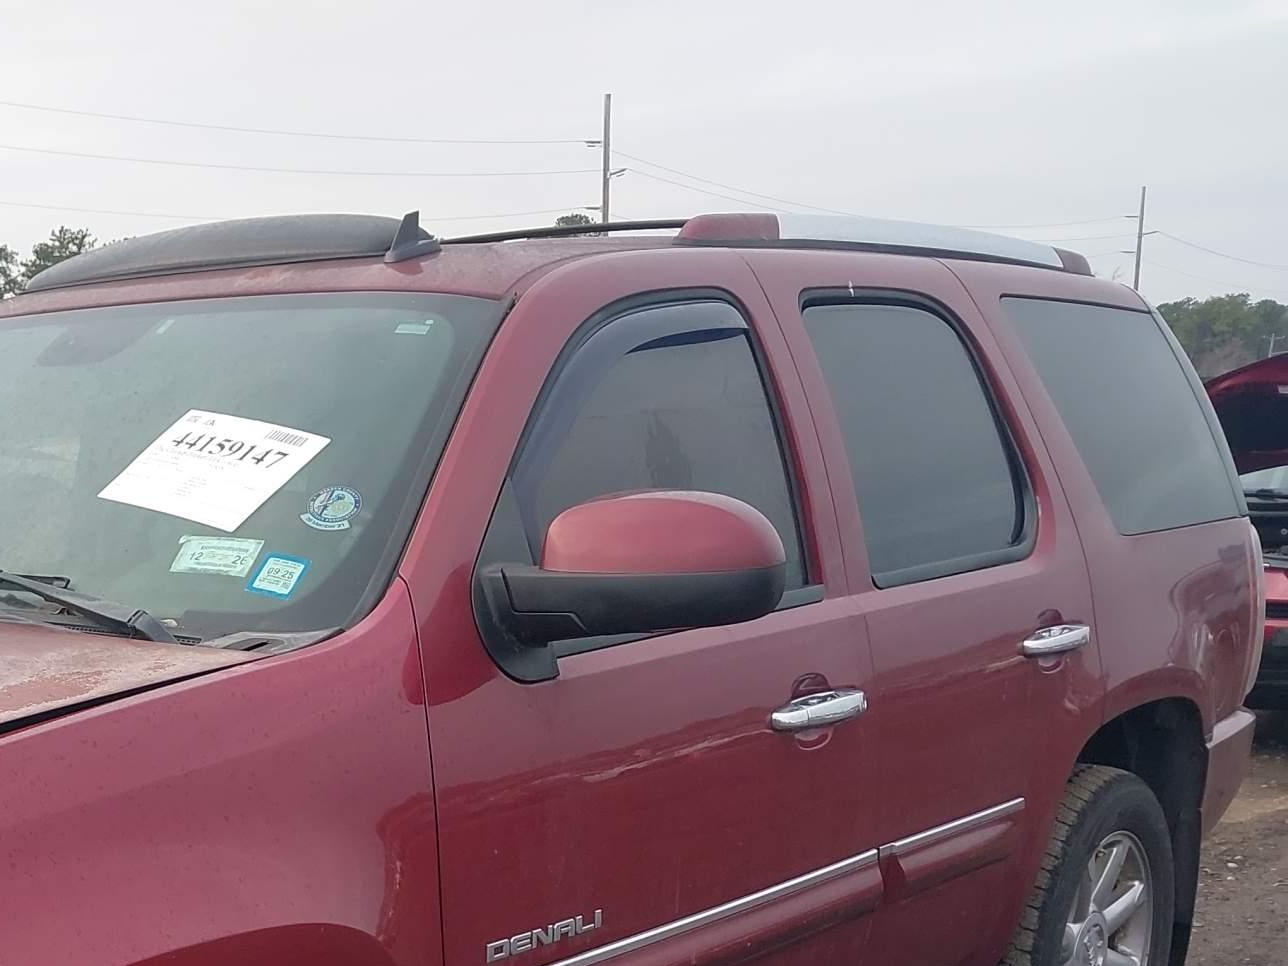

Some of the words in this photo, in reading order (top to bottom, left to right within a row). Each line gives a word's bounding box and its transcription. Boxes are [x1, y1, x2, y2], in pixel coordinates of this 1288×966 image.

[172, 432, 289, 468] 44159147
[189, 551, 204, 561] 12
[486, 908, 602, 964] DENALI
